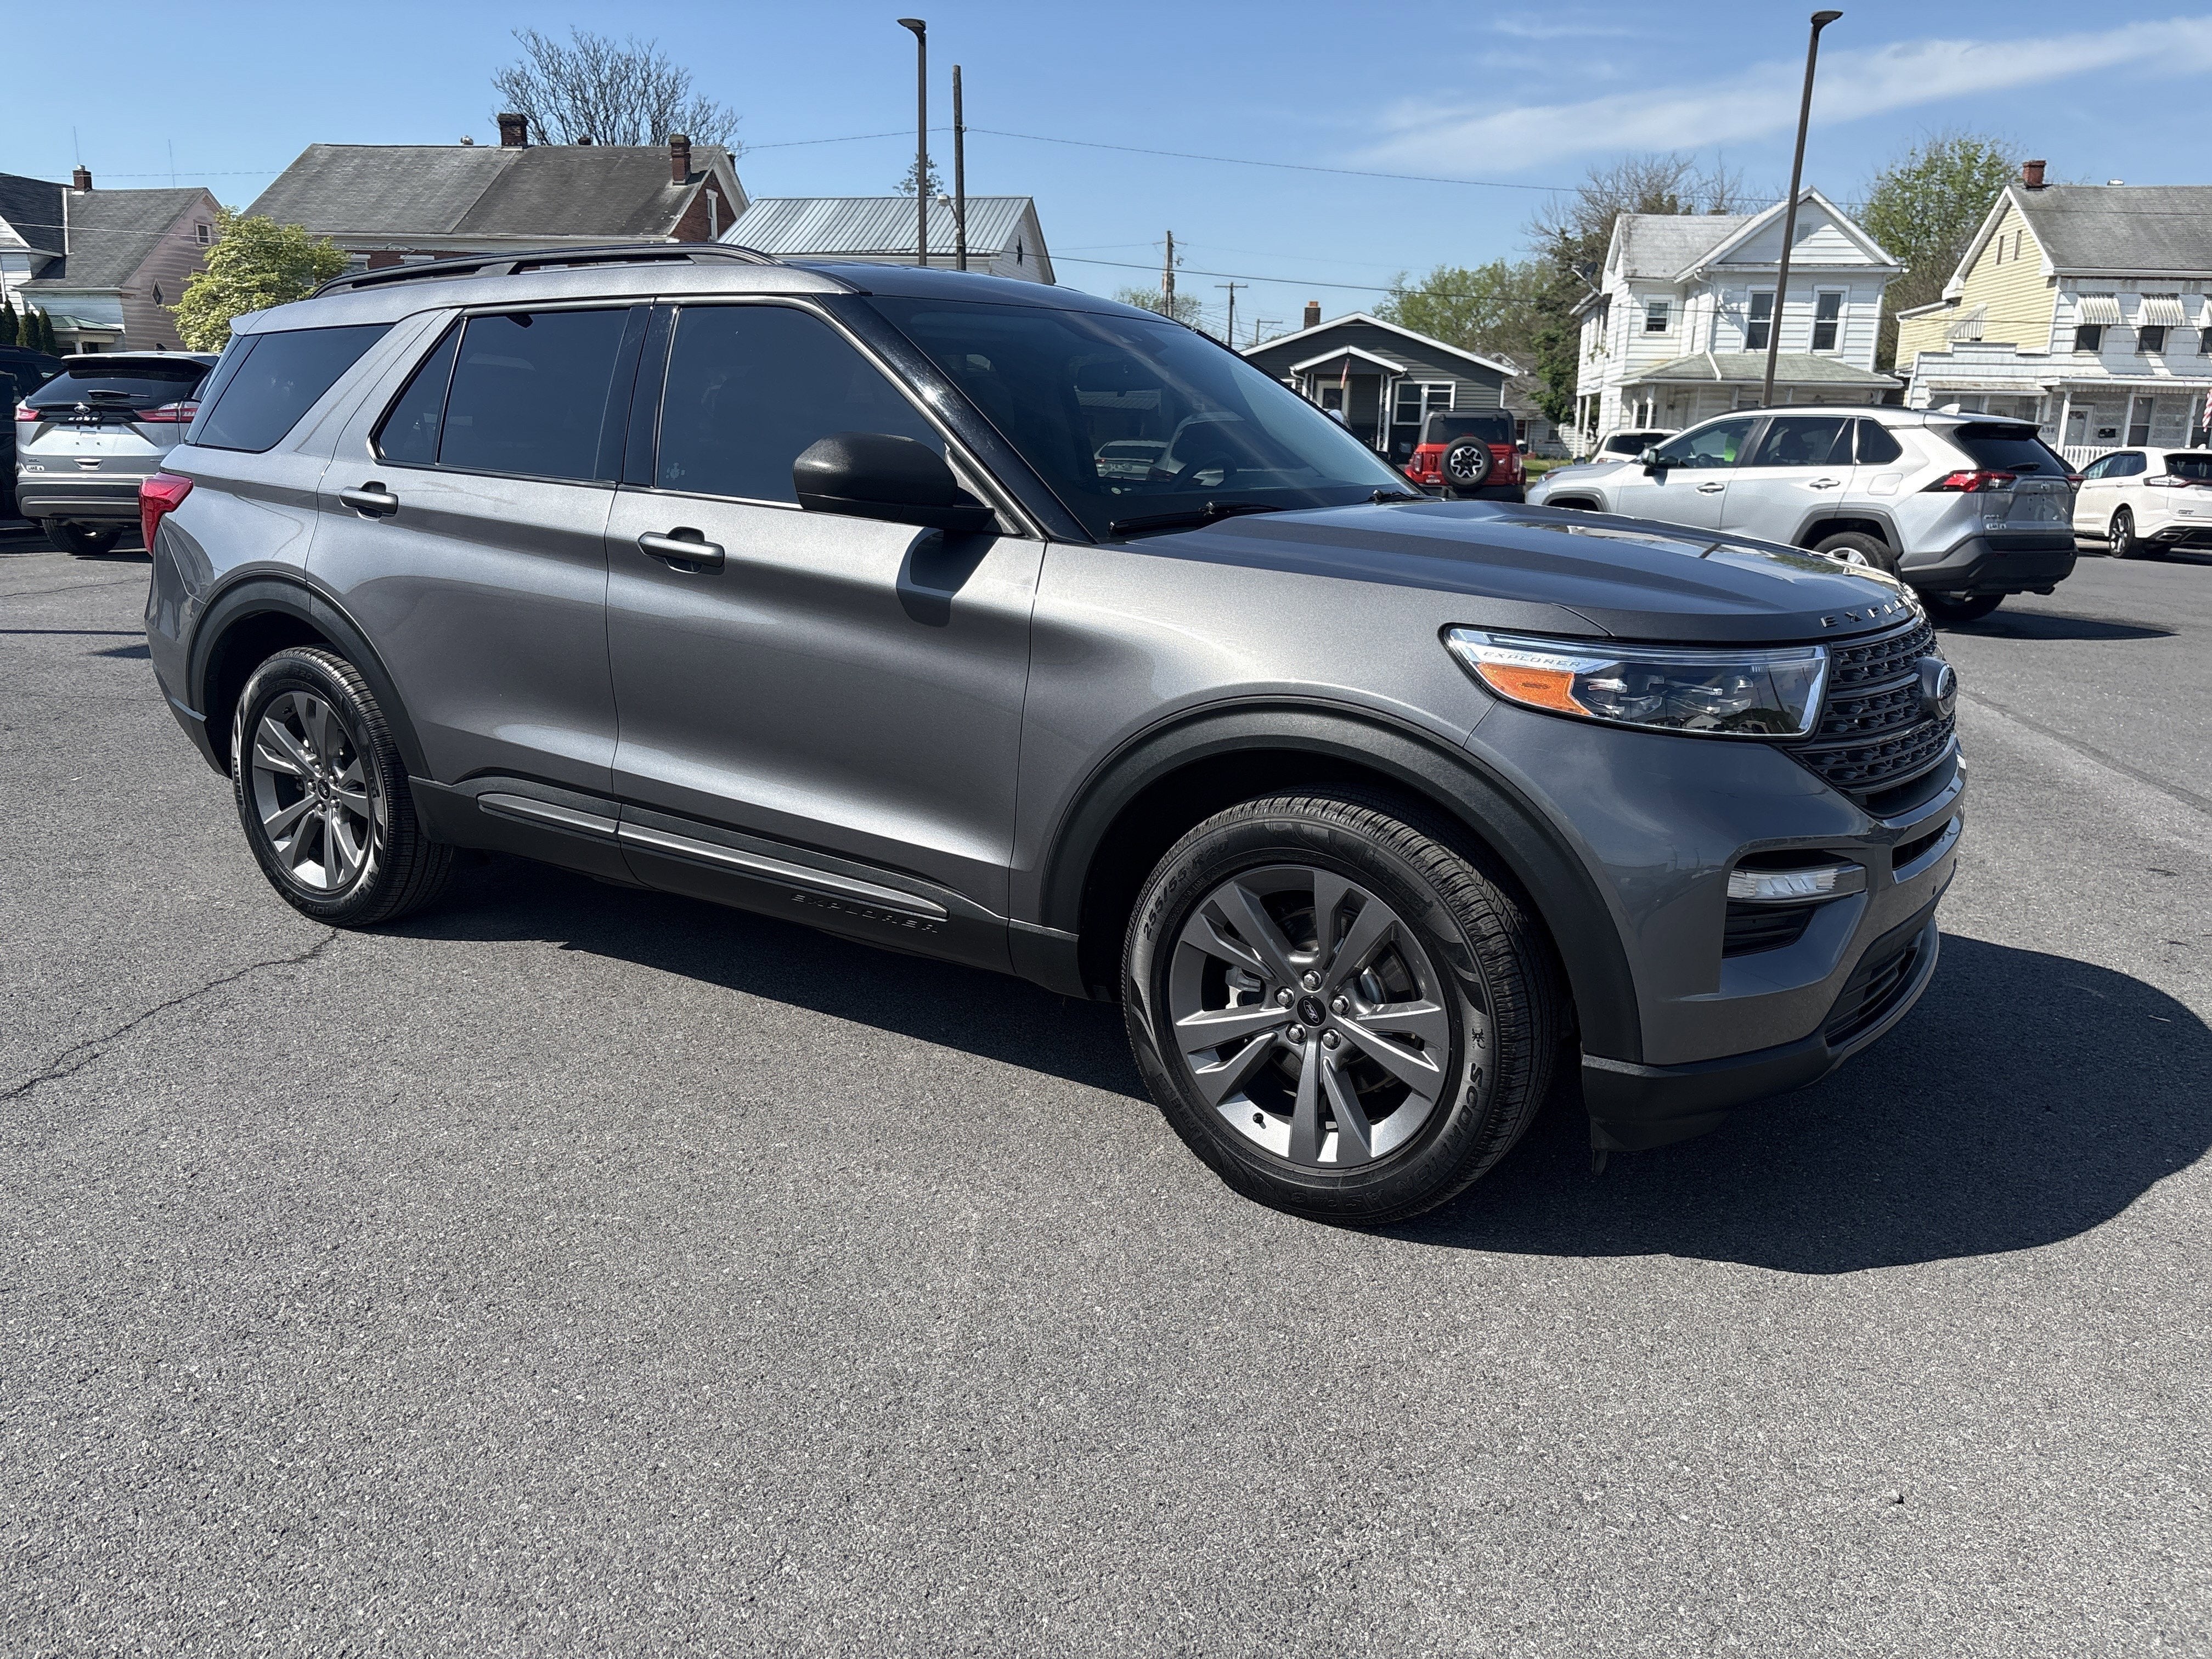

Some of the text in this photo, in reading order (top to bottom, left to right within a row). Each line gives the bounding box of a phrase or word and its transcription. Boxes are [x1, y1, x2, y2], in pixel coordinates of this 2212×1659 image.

[1820, 584, 1917, 628] EXPLO
[1483, 651, 1581, 667] EXPLORER
[791, 893, 939, 934] EXPLORER
[1143, 866, 1187, 940] 255/55
[1396, 1062, 1485, 1197] SCORPION
